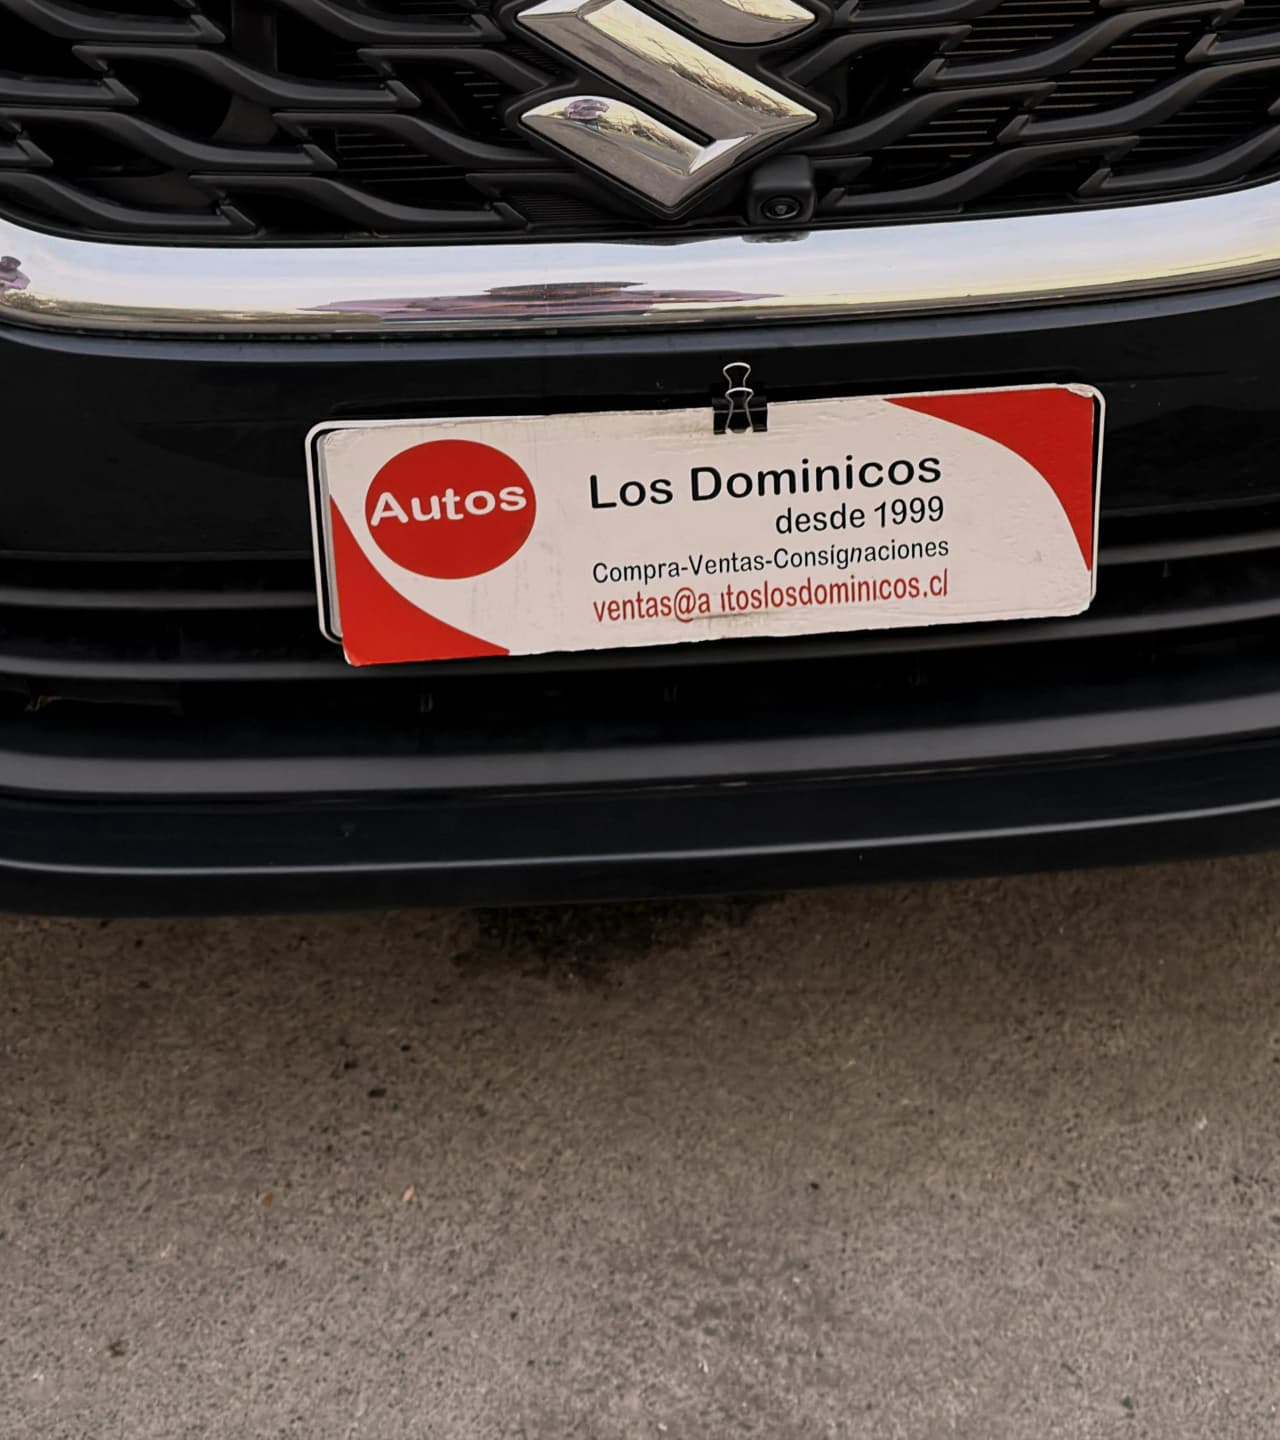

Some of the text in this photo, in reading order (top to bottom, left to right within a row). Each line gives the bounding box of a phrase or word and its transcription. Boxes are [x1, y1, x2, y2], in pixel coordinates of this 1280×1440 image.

[589, 454, 942, 509] Los Dominicos
[370, 486, 528, 527] Autos
[775, 495, 945, 534] desde 1999
